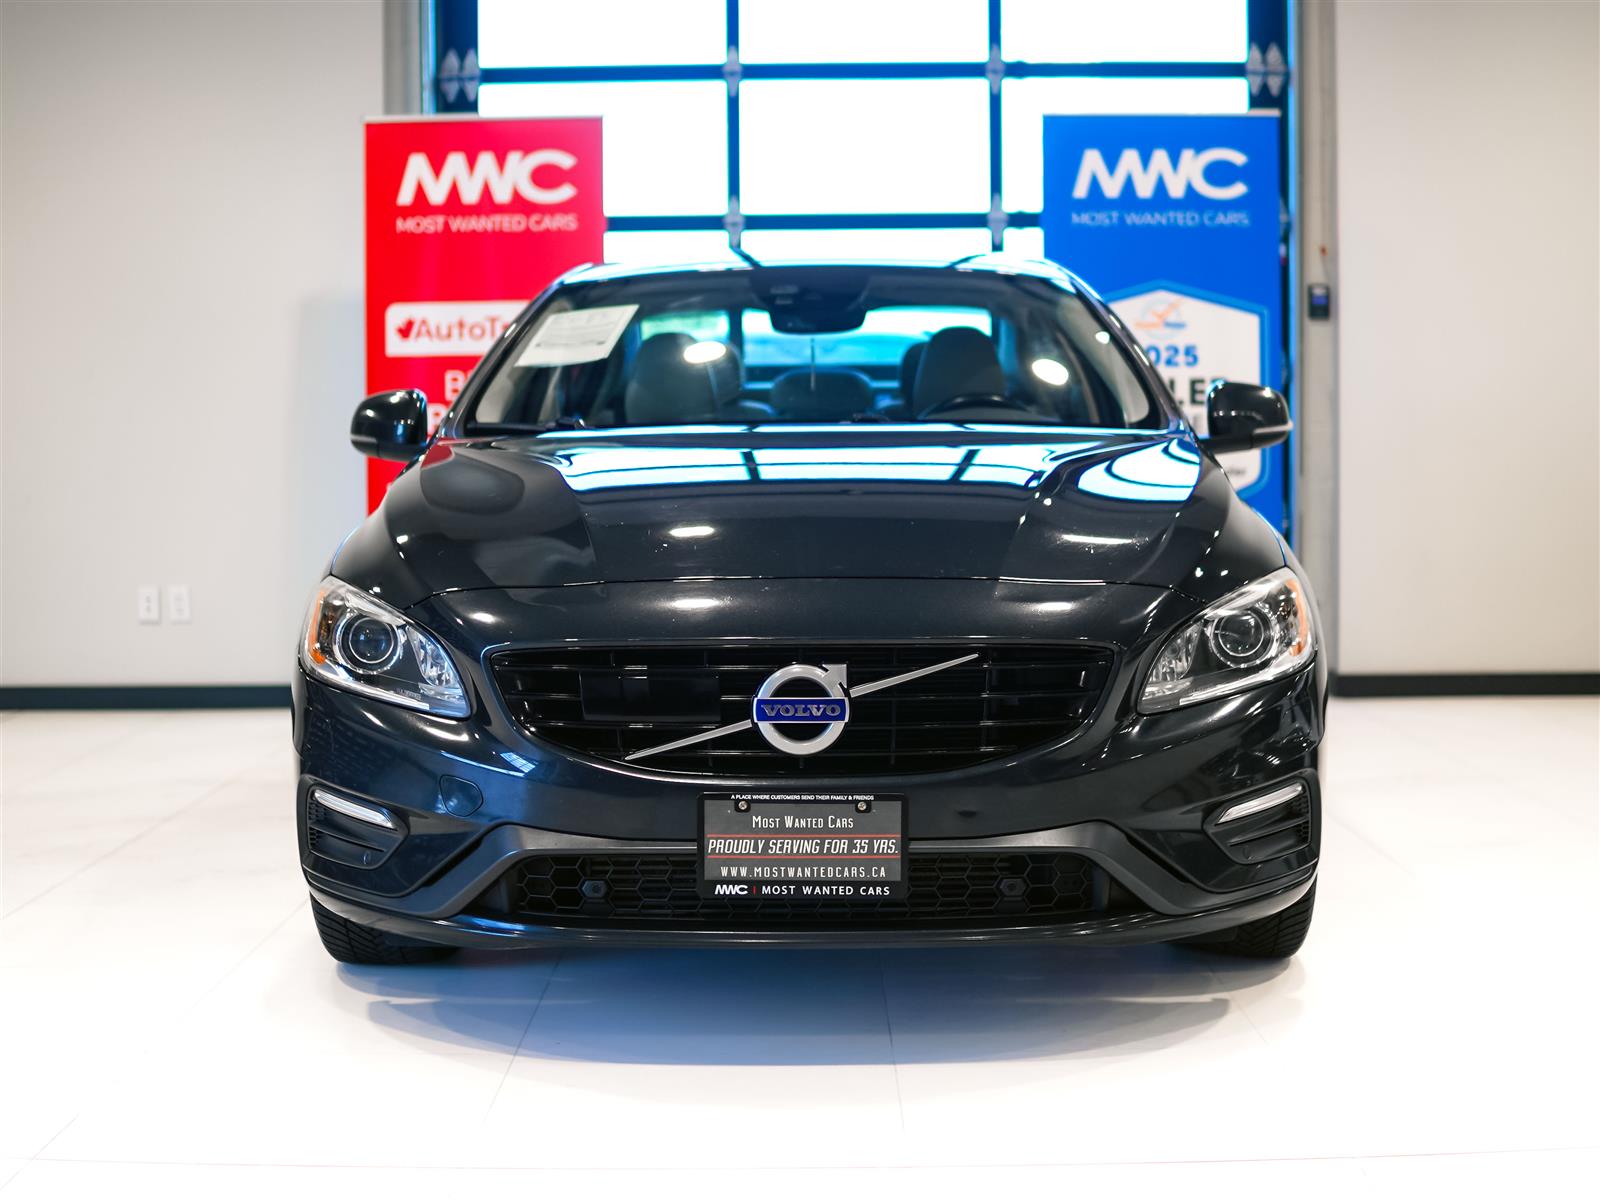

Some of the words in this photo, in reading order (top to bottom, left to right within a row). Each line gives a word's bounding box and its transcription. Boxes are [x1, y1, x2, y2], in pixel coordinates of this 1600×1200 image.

[396, 149, 578, 206] MWC
[1072, 148, 1248, 200] MWC
[396, 215, 446, 234] MOST
[448, 214, 527, 233] WANTED
[528, 213, 579, 232] CARS
[1071, 211, 1119, 225] MOST
[1124, 210, 1200, 225] WANTED
[1203, 211, 1250, 225] CARS
[761, 704, 841, 717] VOLVO
[752, 815, 781, 829] MOST
[784, 815, 824, 829] WANTED
[828, 815, 854, 829] CARS
[708, 839, 765, 854] PROUDLY
[768, 839, 821, 854] SERVING
[823, 839, 849, 854] FOR
[852, 839, 869, 854] 35
[873, 839, 899, 854] YRS.
[720, 866, 887, 878] WWW.MOSTWANTEDCARS.CA
[714, 884, 749, 895] MWC
[761, 885, 796, 895] MOST
[802, 885, 854, 895] WANTED
[859, 886, 890, 896] CARS
